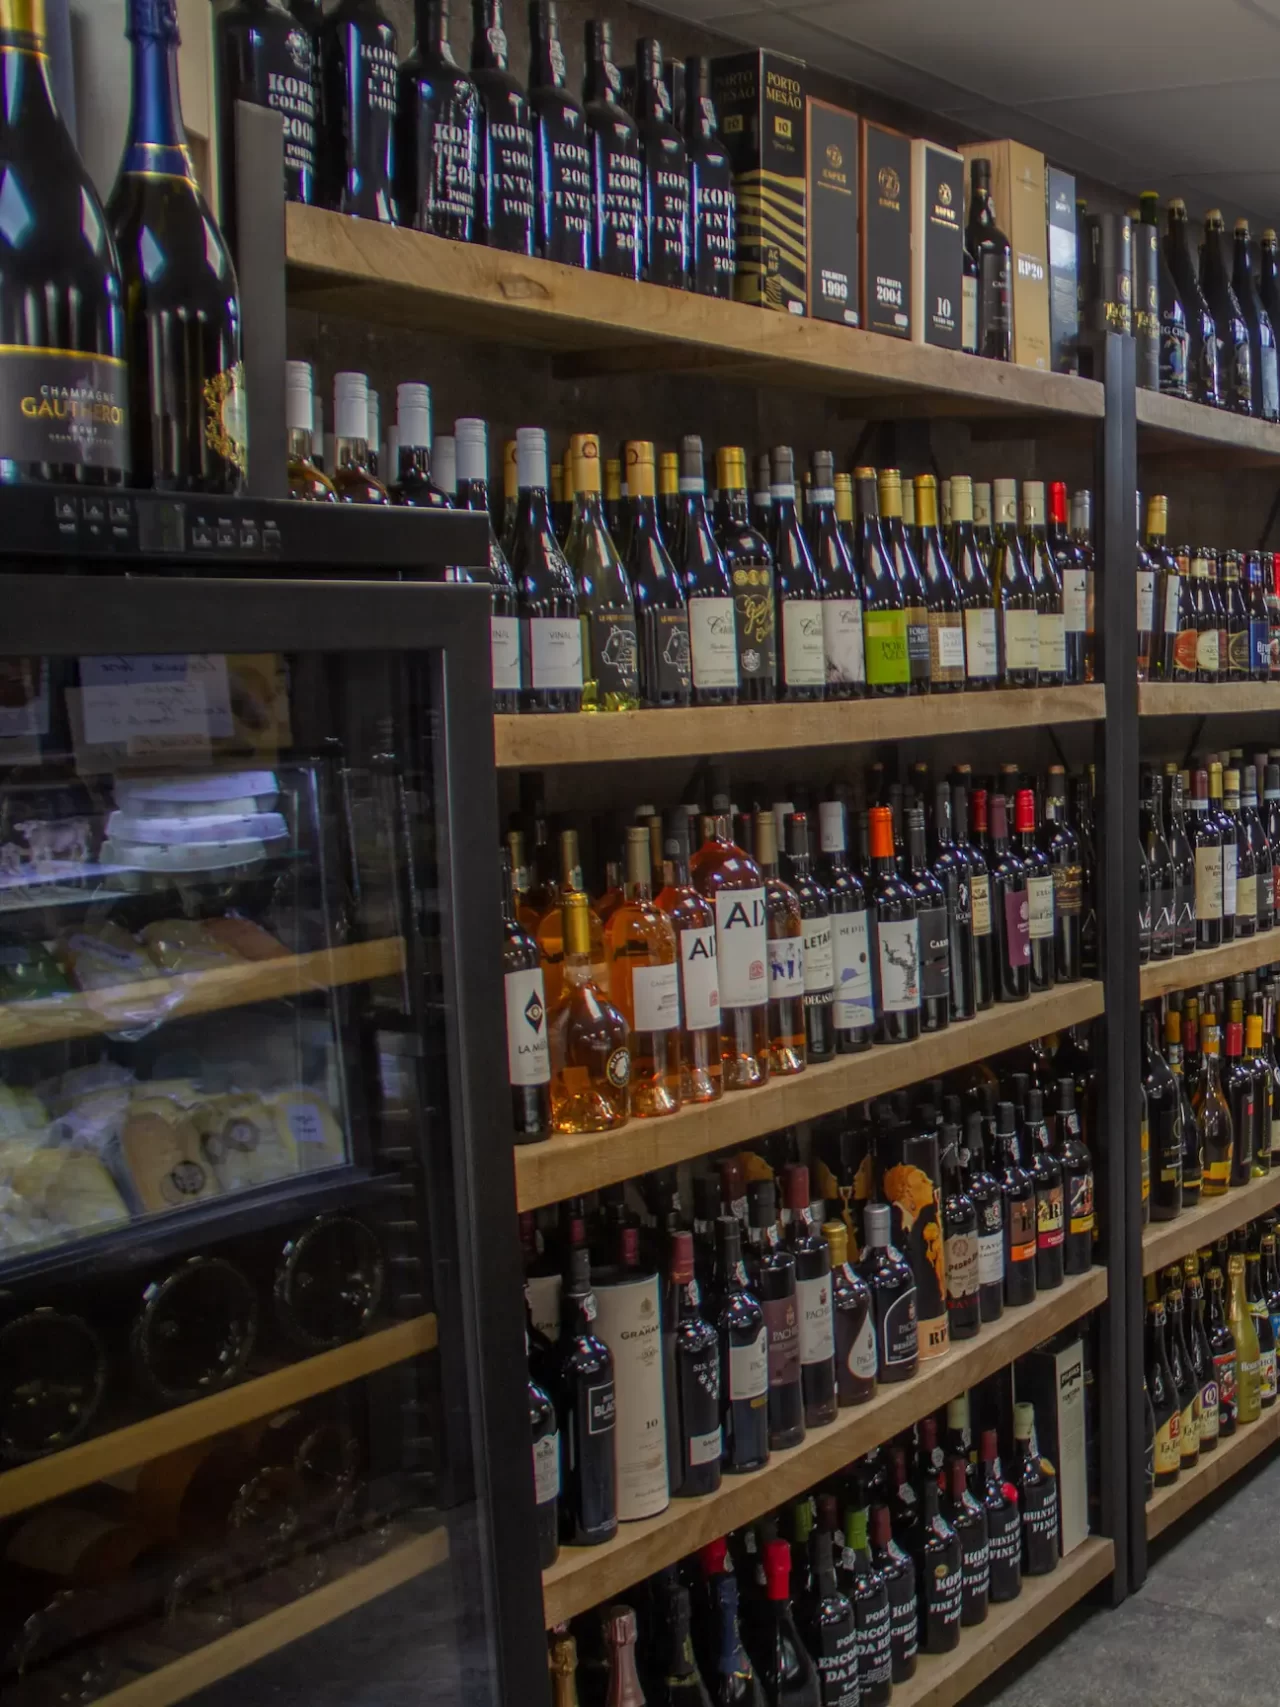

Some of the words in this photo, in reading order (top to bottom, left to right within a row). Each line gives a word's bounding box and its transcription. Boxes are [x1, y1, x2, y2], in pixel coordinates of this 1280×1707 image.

[767, 71, 800, 93] PORTO
[765, 86, 802, 110] MESÃO
[778, 121, 789, 134] 10
[821, 278, 848, 299] 1999
[876, 285, 902, 305] 2004
[937, 297, 951, 317] 10
[40, 384, 116, 401] CHAMPAGNE
[688, 935, 717, 961] AI
[646, 1418, 658, 1430] 10
